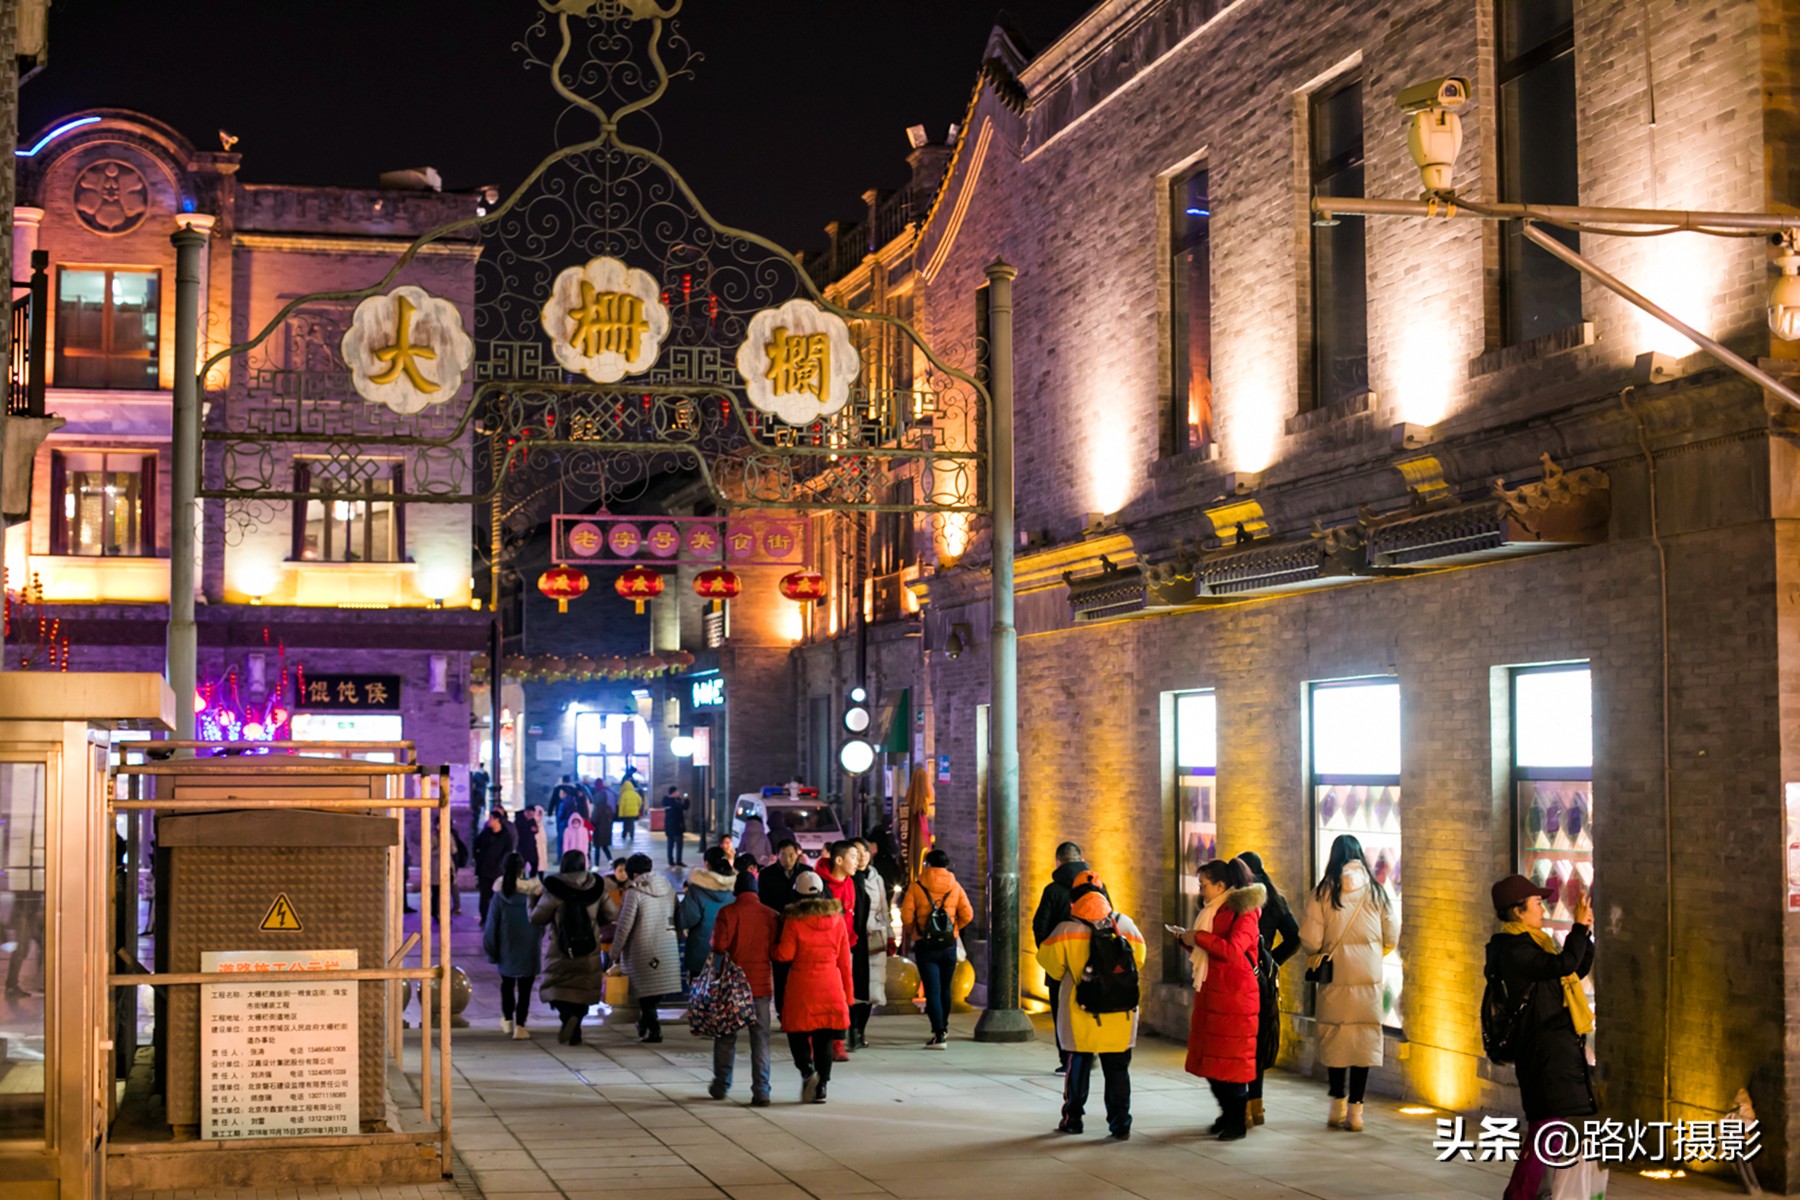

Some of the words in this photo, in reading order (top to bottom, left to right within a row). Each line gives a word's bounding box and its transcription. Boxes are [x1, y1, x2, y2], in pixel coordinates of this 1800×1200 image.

[574, 531, 792, 551] 老字号美食街
[308, 681, 389, 704] 馄饨侯
[247, 1036, 275, 1045] 道办事处
[289, 1047, 304, 1055] 电话
[290, 1070, 304, 1078] 电话
[290, 1093, 304, 1101] 电话
[290, 1116, 304, 1124] 电话
